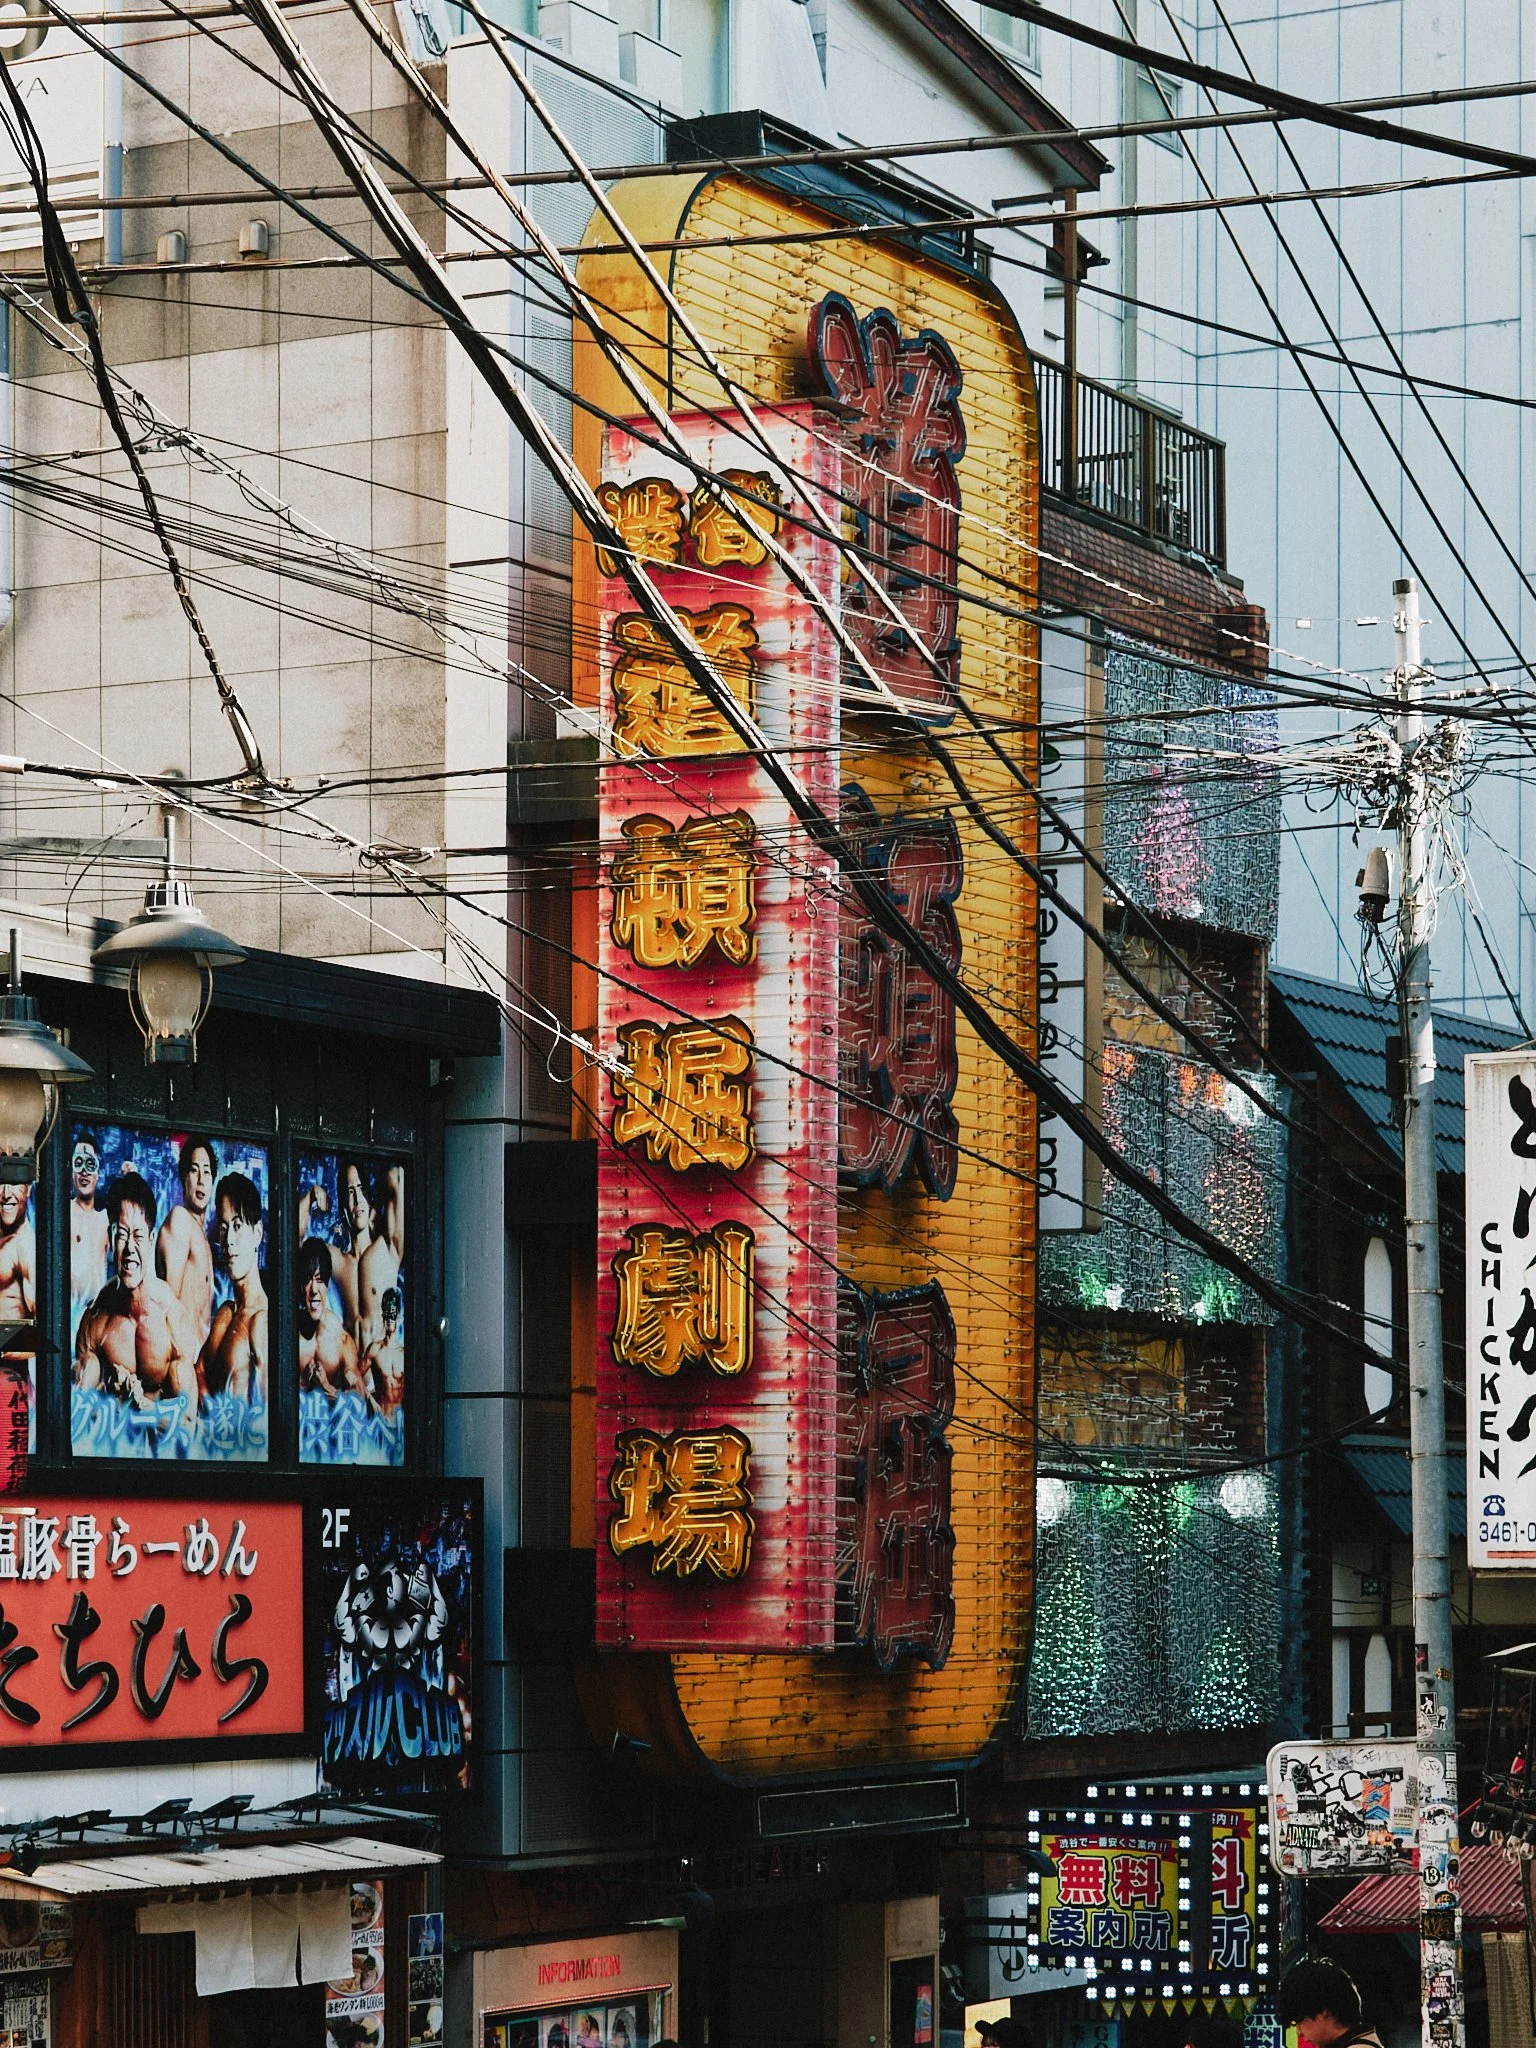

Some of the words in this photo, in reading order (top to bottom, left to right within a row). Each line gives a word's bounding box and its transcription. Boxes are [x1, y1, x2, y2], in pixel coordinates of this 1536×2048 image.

[595, 468, 782, 578] 渋谷
[1480, 1222, 1503, 1480] CHICKEN
[322, 1508, 350, 1548] 2F
[1287, 1825, 1319, 1848] ADNATE
[1058, 1853, 1162, 1908] 無料
[1425, 1867, 1439, 1884] 13
[1048, 1906, 1171, 1950] 案内所
[538, 1955, 621, 1985] INFORMATION
